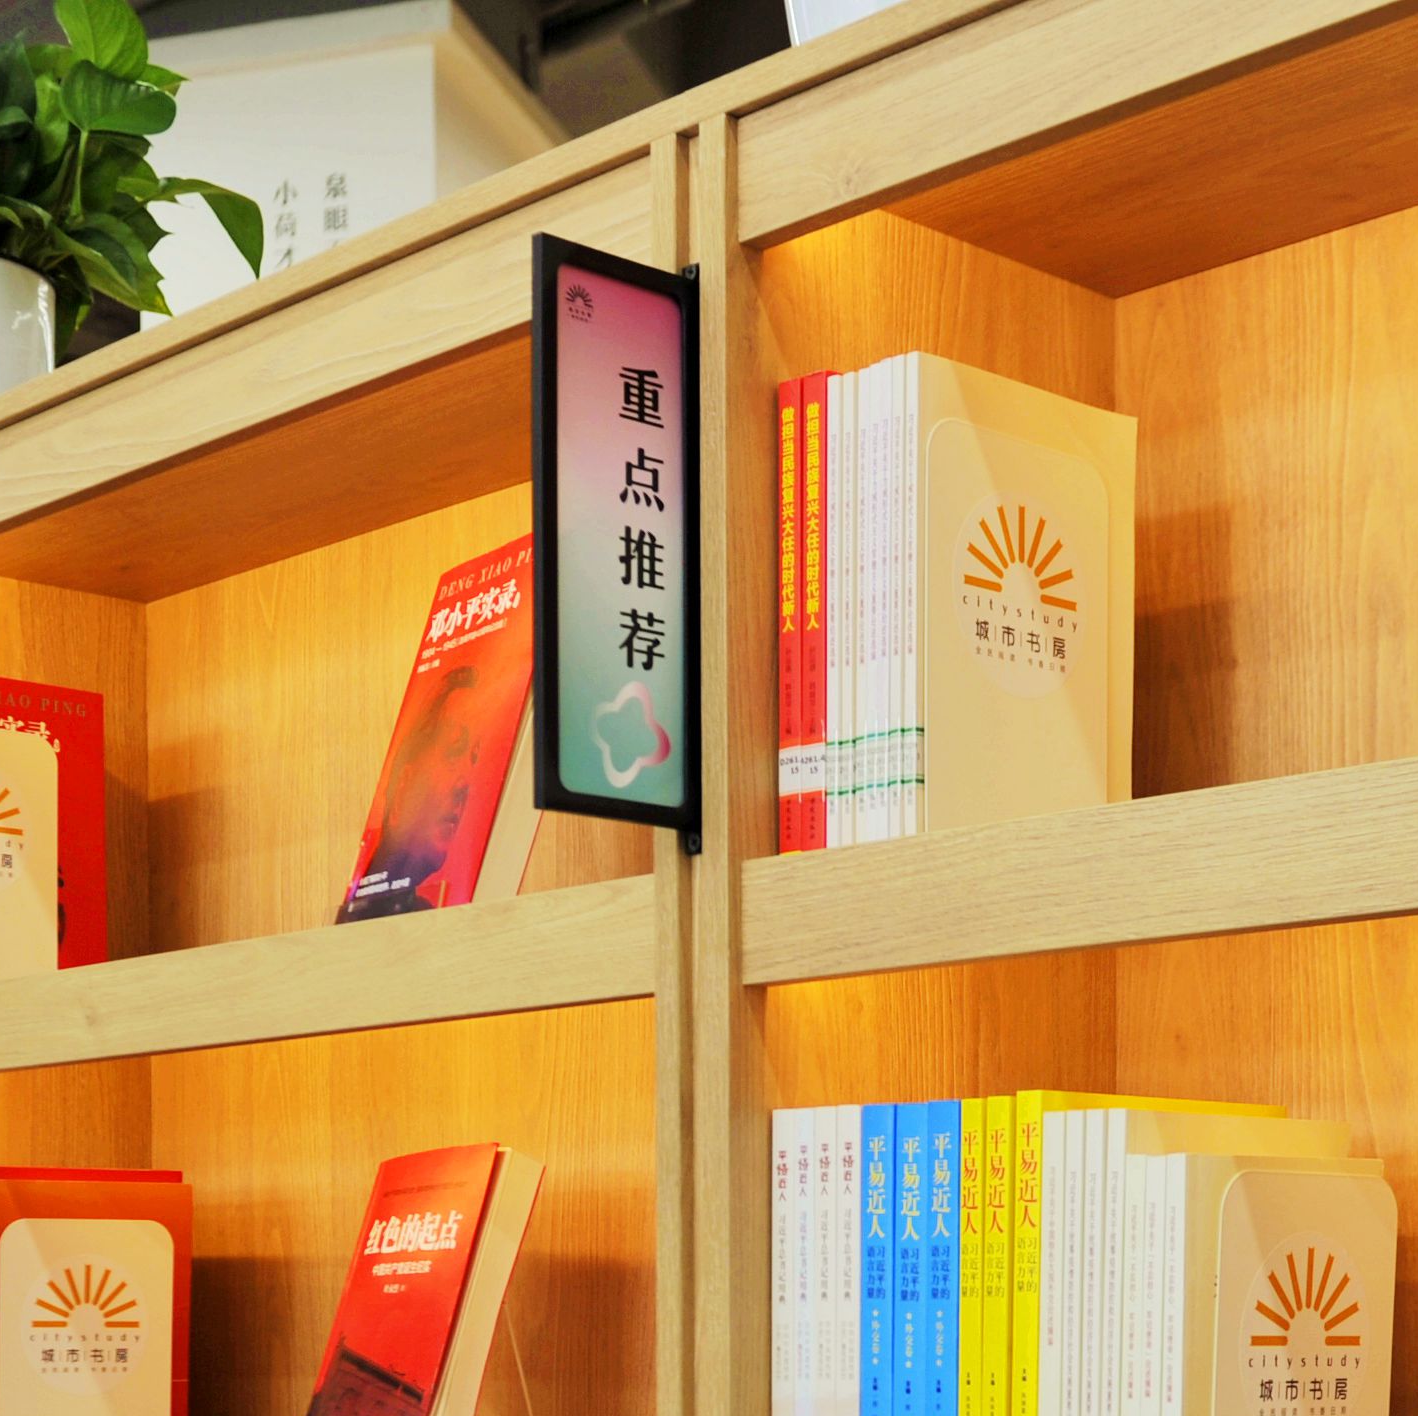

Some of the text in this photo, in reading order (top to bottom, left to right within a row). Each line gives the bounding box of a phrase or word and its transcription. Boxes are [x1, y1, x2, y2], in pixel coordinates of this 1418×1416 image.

[322, 171, 349, 248] 泉眼
[617, 366, 667, 672] 重点推荐
[439, 545, 533, 602] DENG XIAO PI
[962, 594, 1078, 633] citystudy
[975, 618, 1067, 660] 城市书房
[40, 697, 87, 718] PING
[867, 1134, 887, 1240] 平易近人
[900, 1135, 922, 1242] 平易近人
[931, 1131, 953, 1239] 平易近人
[961, 1128, 980, 1236] 平易近人
[986, 1127, 1007, 1235] 平易近人
[1017, 1120, 1040, 1230] 平易近人
[364, 1209, 464, 1256] 红色的起点
[40, 1346, 130, 1365] 城市书房
[1248, 1353, 1361, 1370] citystudy
[1258, 1377, 1349, 1403] 城市书房
